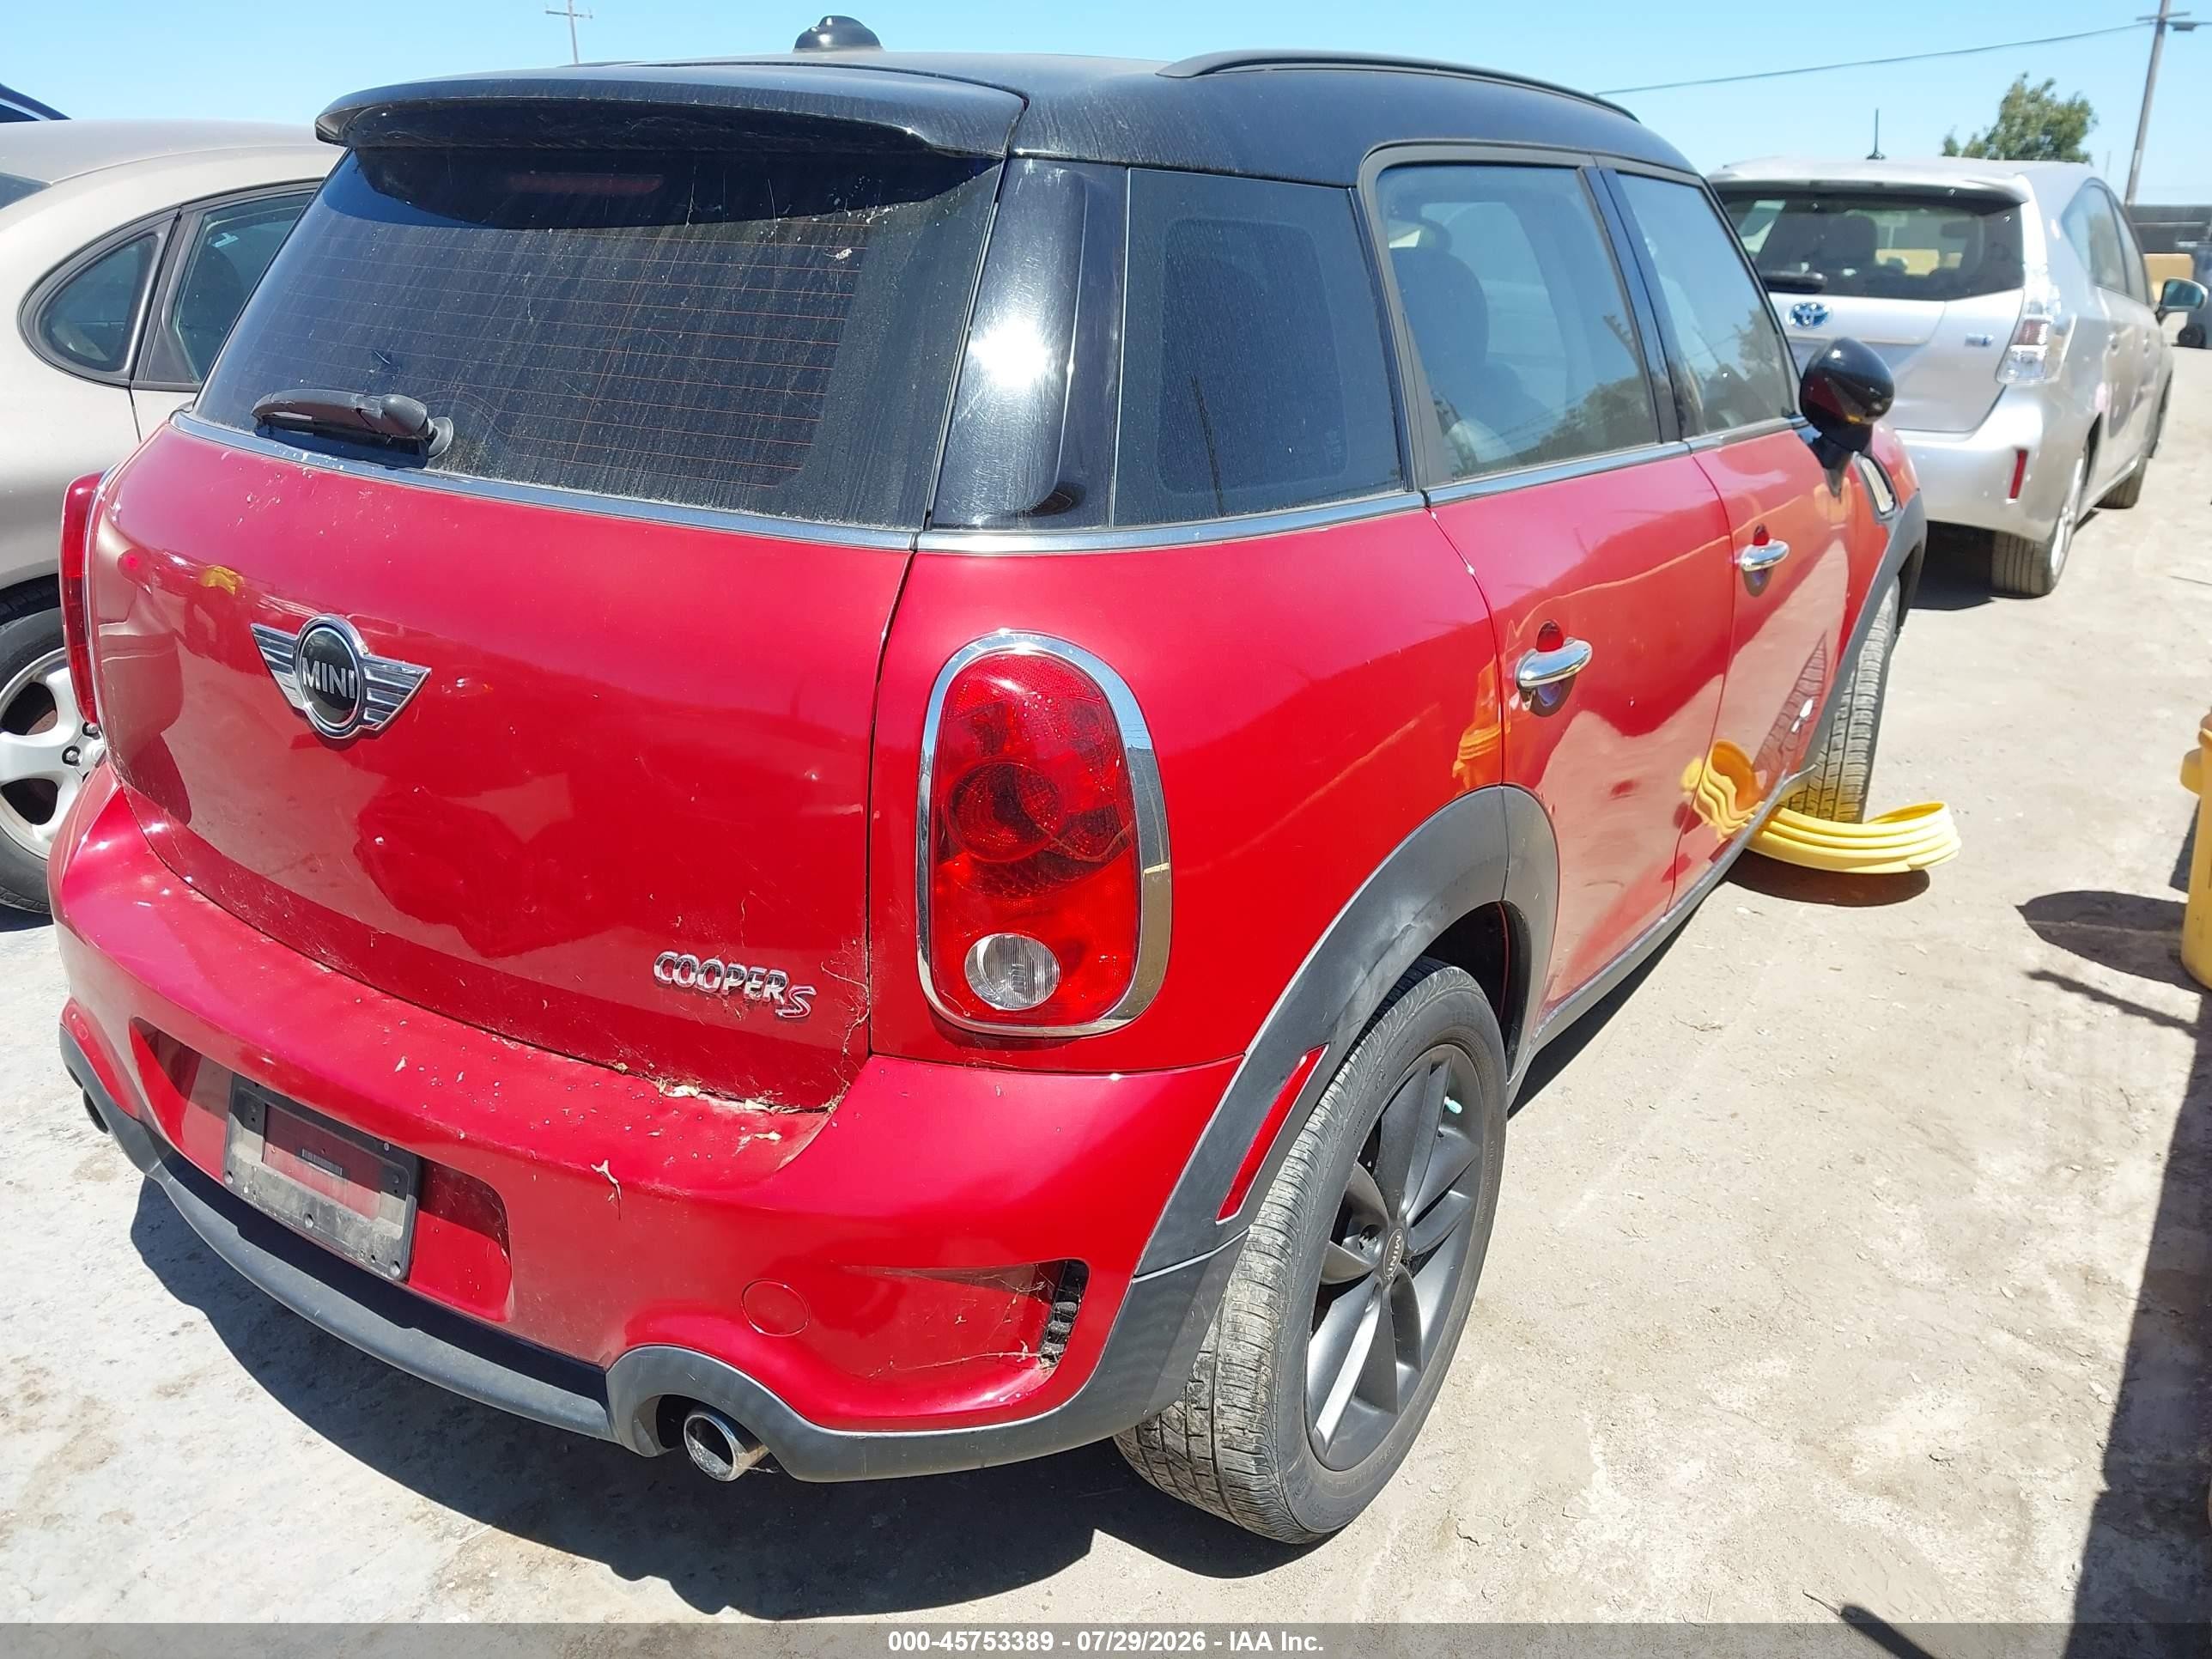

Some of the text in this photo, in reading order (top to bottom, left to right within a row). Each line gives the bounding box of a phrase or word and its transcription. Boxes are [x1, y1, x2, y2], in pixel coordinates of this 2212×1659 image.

[301, 657, 356, 699] MINI
[653, 951, 817, 1018] COOPER S
[1388, 1235, 1401, 1272] MINI
